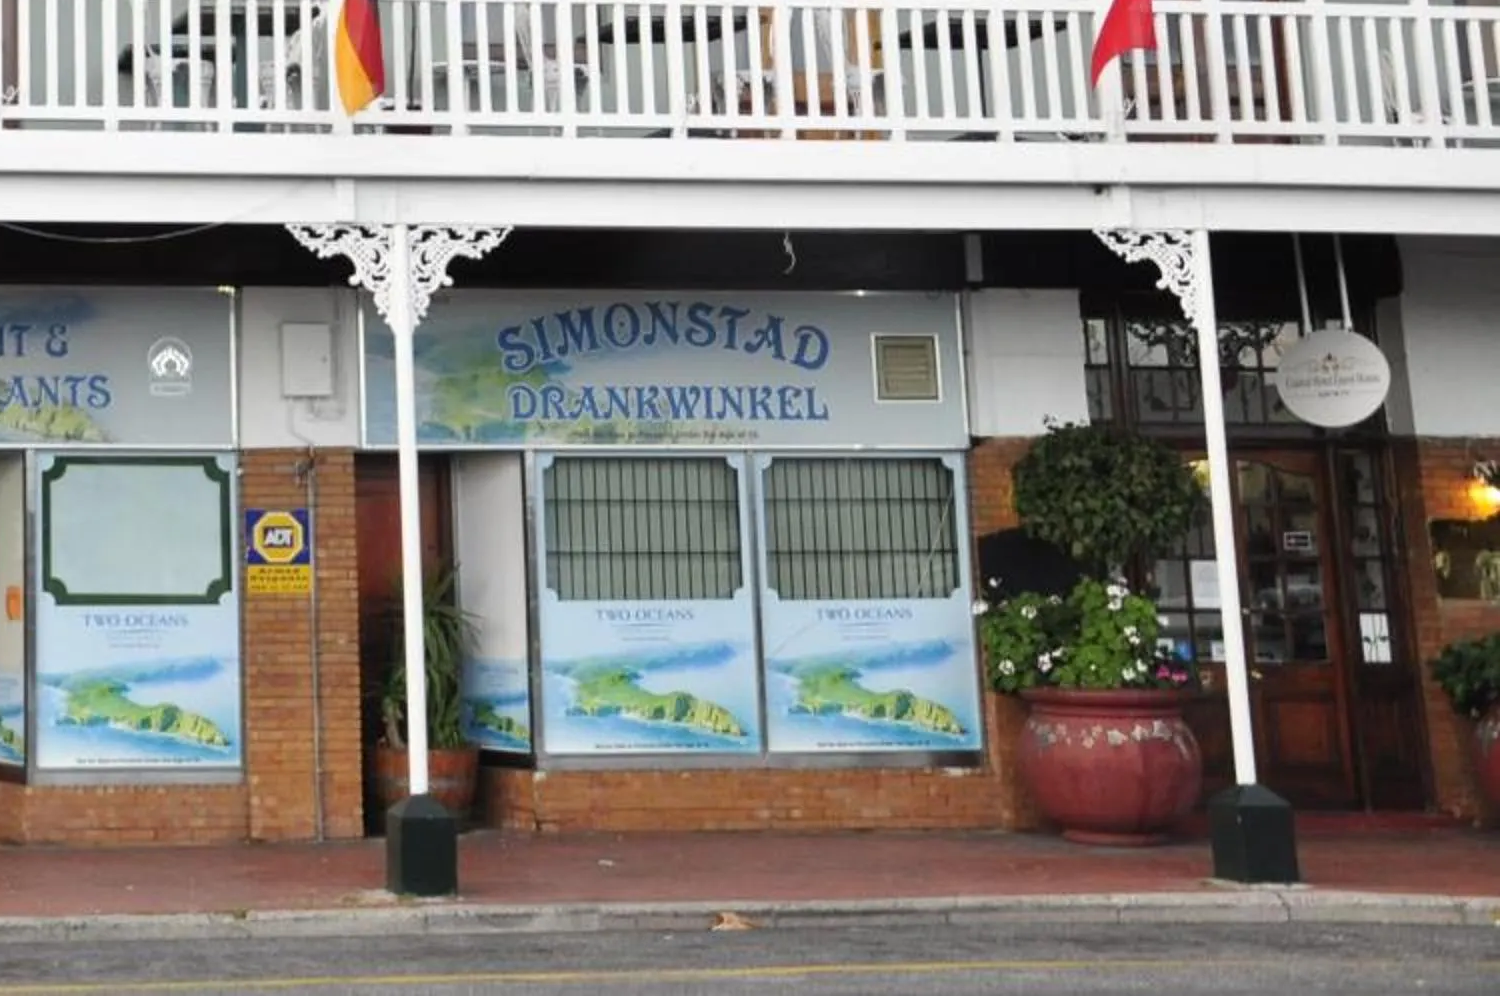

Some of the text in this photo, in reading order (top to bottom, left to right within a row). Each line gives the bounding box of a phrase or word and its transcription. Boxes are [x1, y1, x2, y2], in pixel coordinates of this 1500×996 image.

[45, 323, 69, 358] &
[497, 300, 830, 371] SIMONSTAD
[511, 384, 830, 422] DRANKWINKEL
[263, 527, 293, 546] ADT
[84, 613, 121, 628] TWO
[596, 608, 631, 621] TWO
[816, 607, 850, 621] TWO
